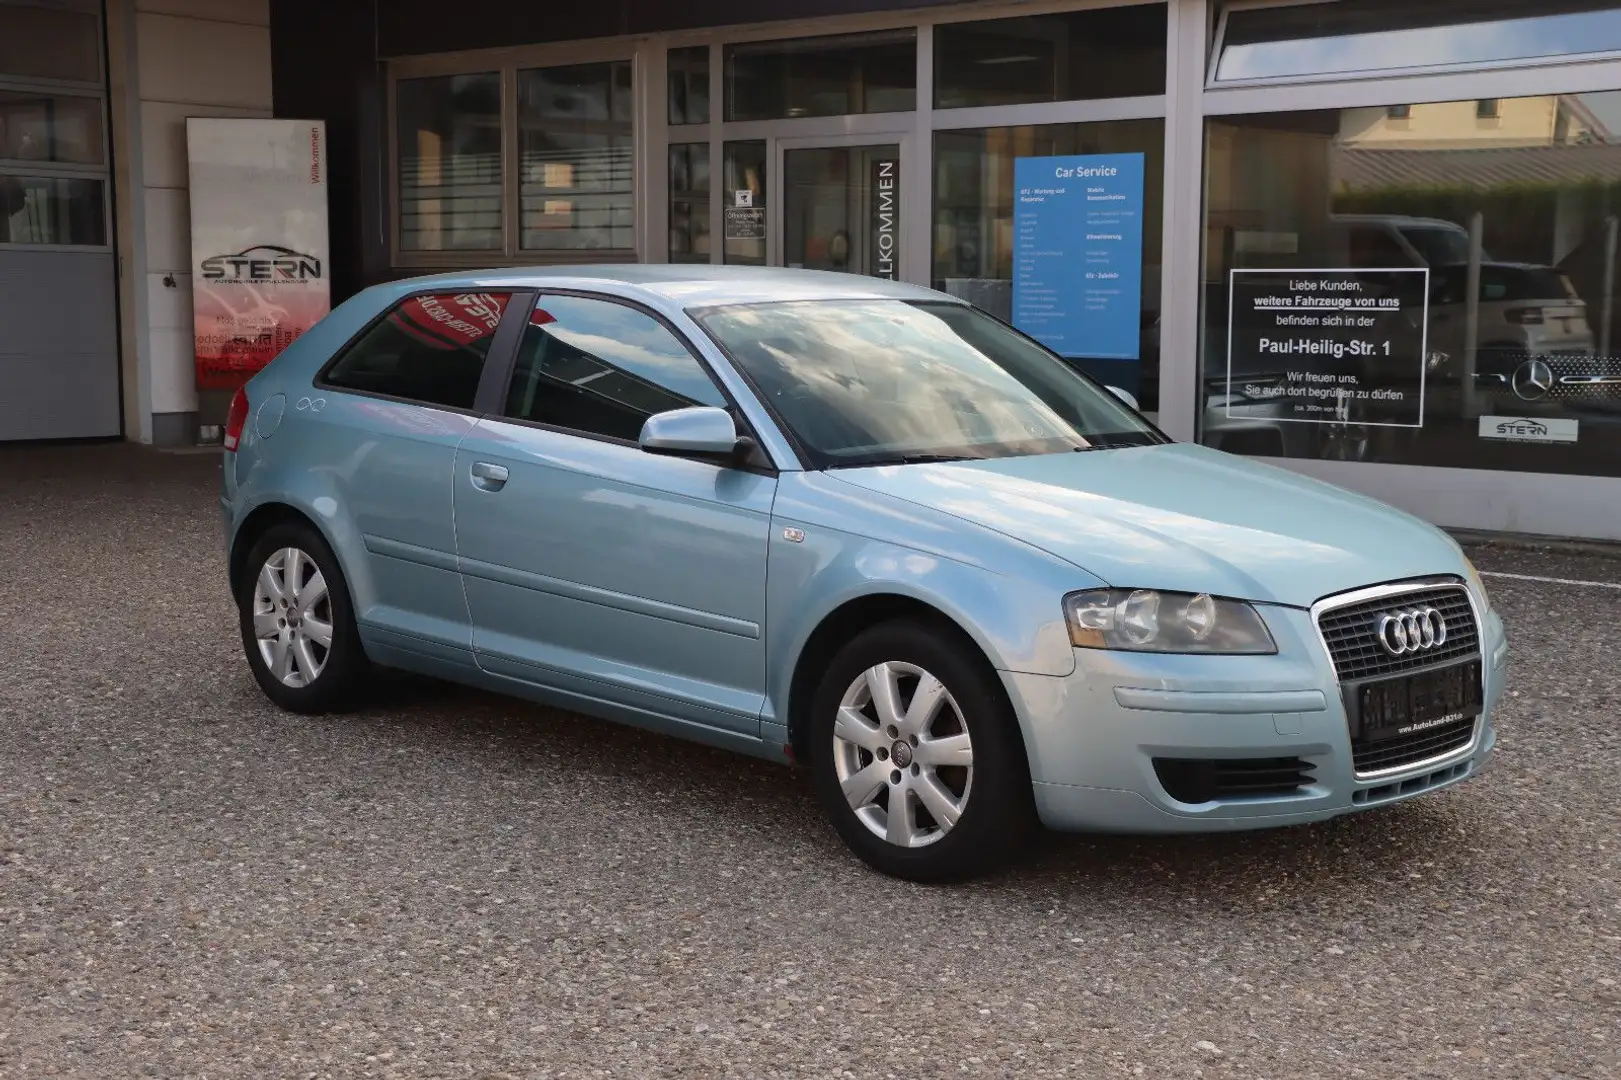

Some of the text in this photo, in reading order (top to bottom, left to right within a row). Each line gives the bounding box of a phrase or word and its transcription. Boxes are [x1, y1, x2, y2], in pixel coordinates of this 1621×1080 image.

[311, 127, 320, 184] Willkommen
[1055, 165, 1117, 178] Car Service
[201, 260, 321, 279] STERN
[1289, 280, 1363, 292] Liebe Kunden,
[1254, 296, 1400, 308] weitere Fahrzeuge von uns
[1276, 314, 1376, 327] befinden sich in der
[1259, 338, 1390, 358] Paul-Heilig-Str. 1
[1286, 372, 1359, 384] Wir freuen uns,
[1245, 384, 1260, 394] Sie
[1262, 386, 1286, 395] auch
[1287, 386, 1306, 396] dort
[1356, 391, 1369, 399] zu
[1371, 389, 1403, 400] dürfen
[1496, 425, 1547, 435] STERN
